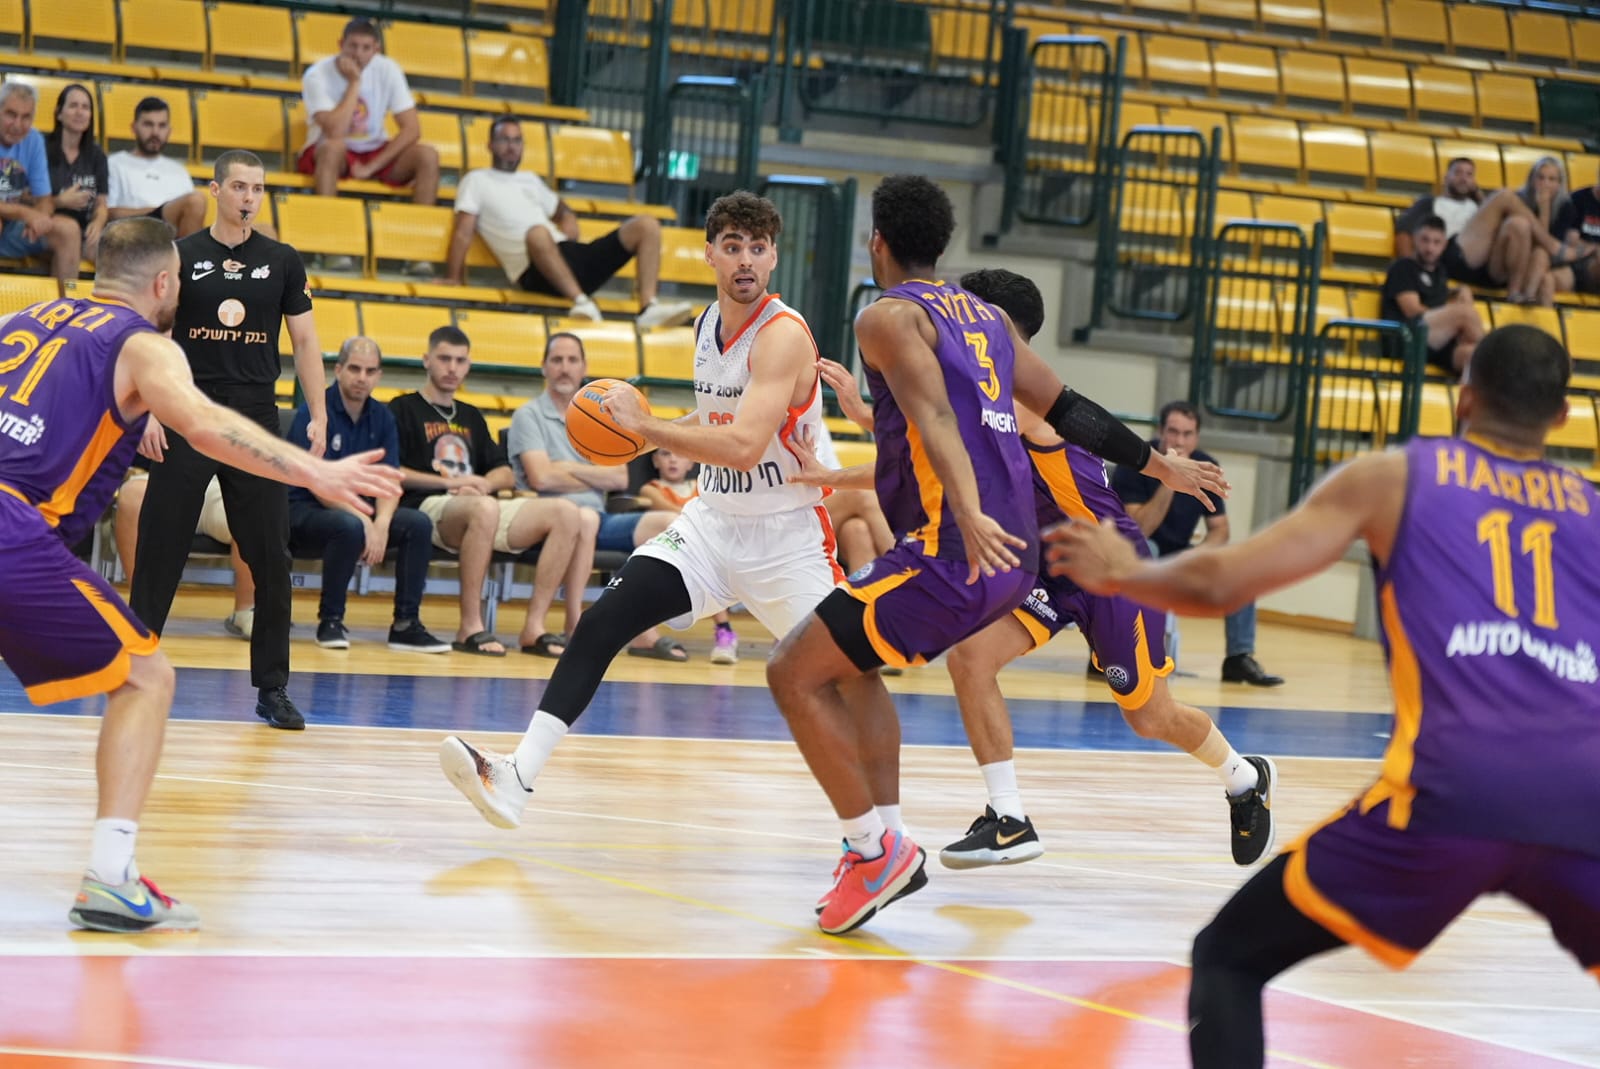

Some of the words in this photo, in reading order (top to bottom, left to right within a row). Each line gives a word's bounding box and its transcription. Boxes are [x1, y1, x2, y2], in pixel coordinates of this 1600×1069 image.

[0, 330, 68, 406] 21
[188, 327, 241, 342] ירושלים
[245, 331, 268, 344] בנק
[964, 331, 1000, 401] 3
[1436, 447, 1590, 517] HARRIS
[1476, 509, 1559, 630] 11
